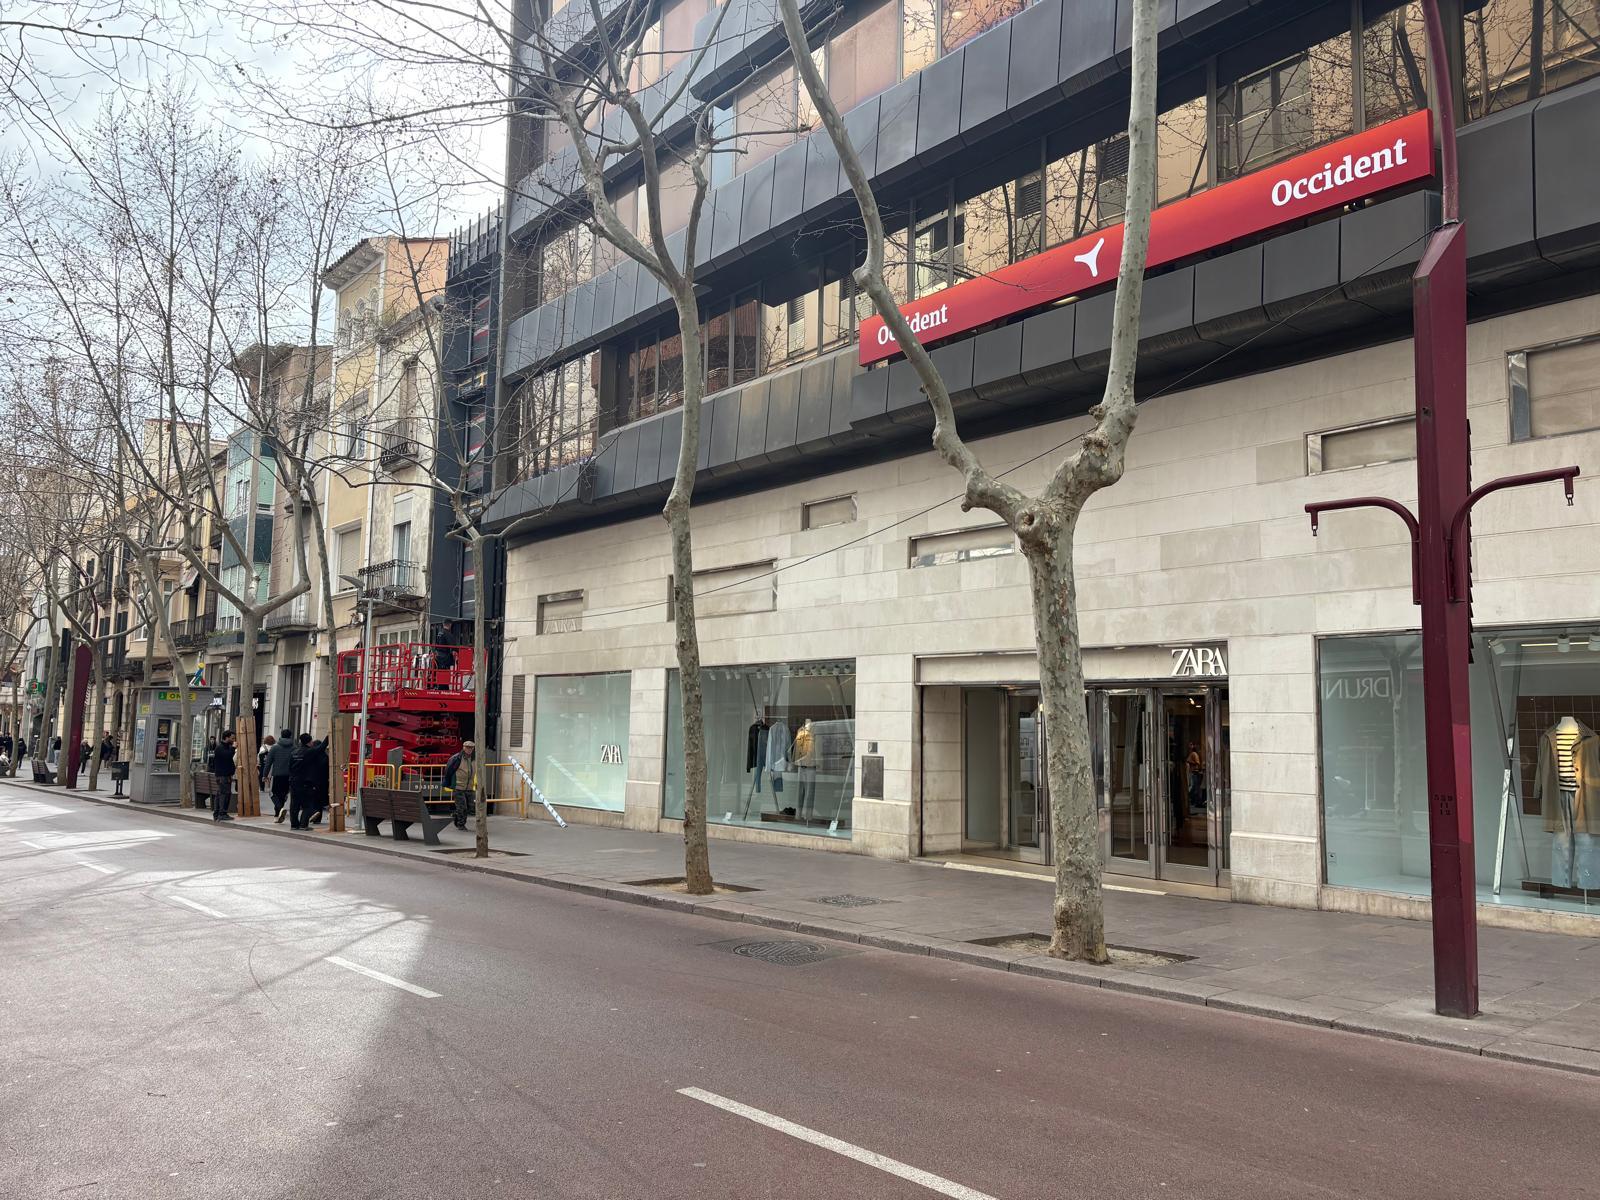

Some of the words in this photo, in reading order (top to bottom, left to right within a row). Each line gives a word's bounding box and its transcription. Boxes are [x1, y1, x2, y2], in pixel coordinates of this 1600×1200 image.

[1271, 138, 1408, 207] Occident
[877, 303, 948, 345] Ocdent
[1171, 647, 1228, 677] ZARA
[600, 744, 623, 764] ZARA
